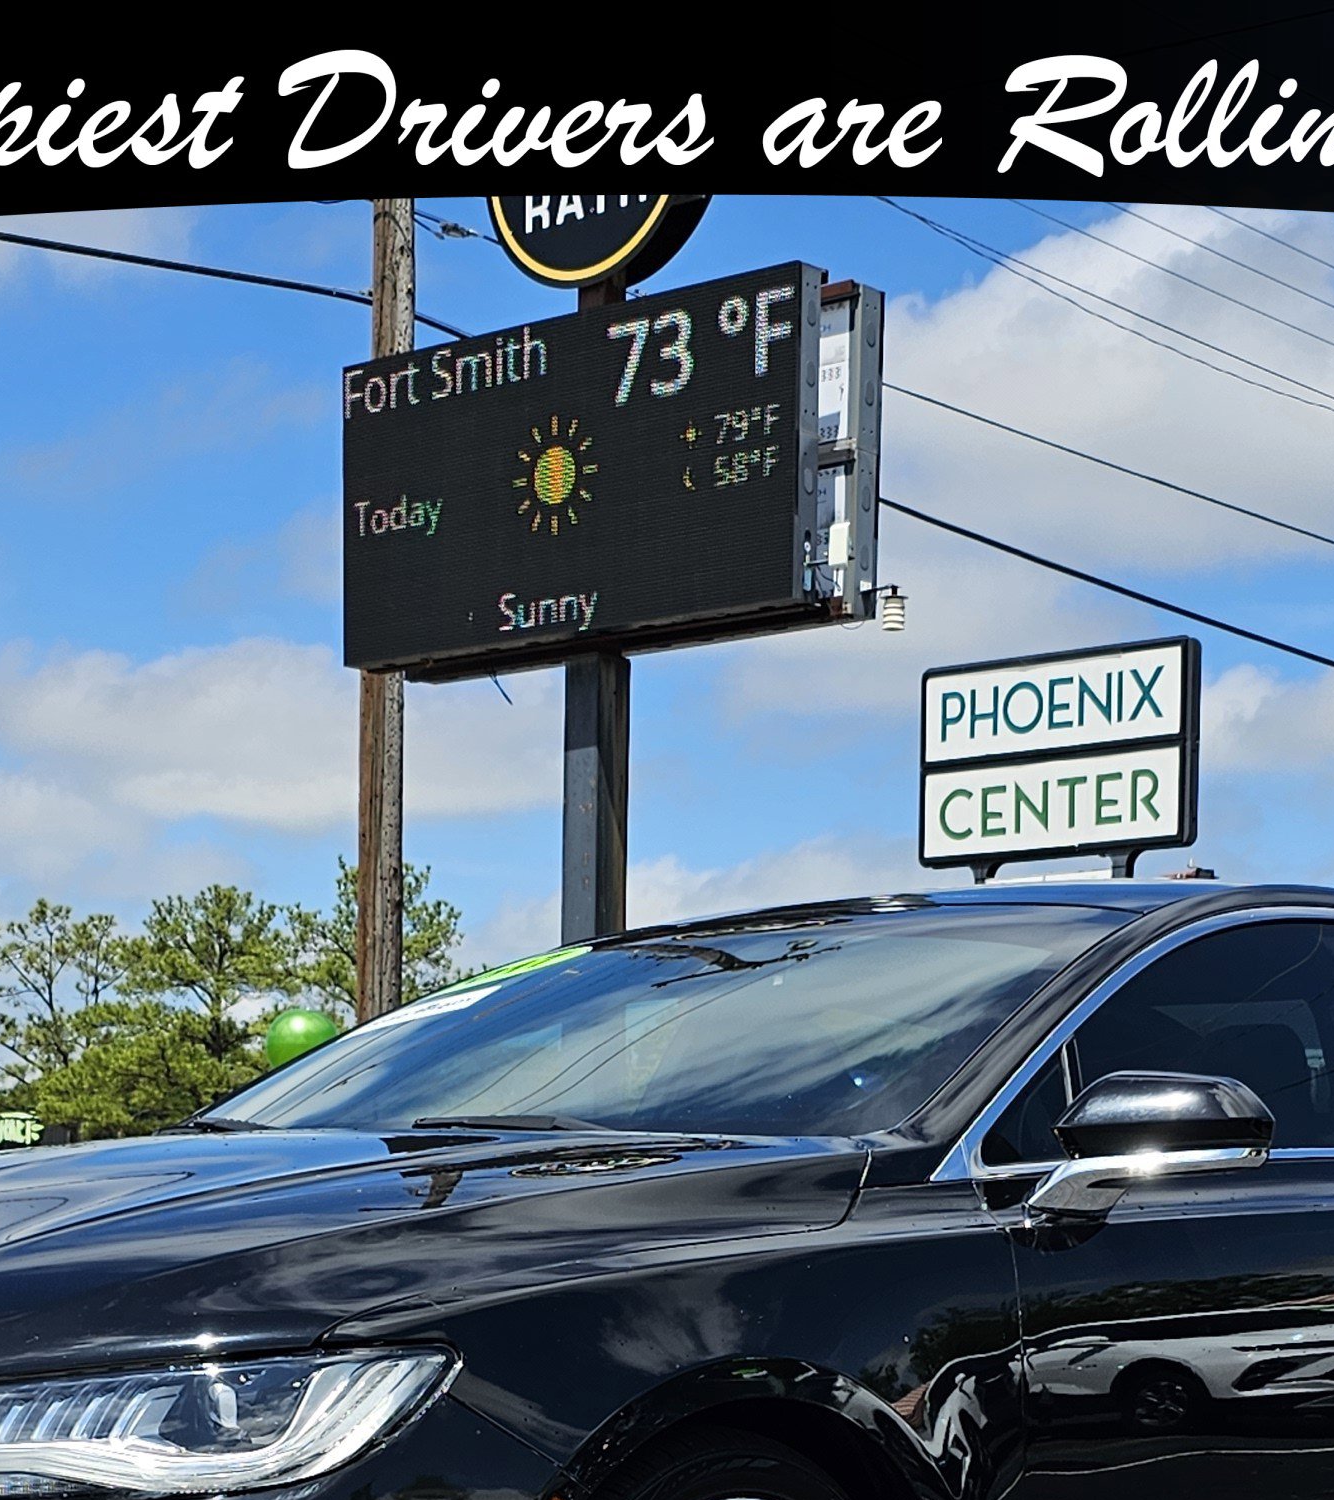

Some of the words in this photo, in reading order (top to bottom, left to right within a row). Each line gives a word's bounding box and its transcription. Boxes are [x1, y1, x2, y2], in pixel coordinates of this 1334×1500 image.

[343, 360, 421, 420] Fort
[430, 325, 547, 401] Smith
[606, 308, 695, 408] 73
[714, 403, 781, 445] 79°F
[352, 494, 443, 538] Today
[497, 592, 599, 632] Sunny
[940, 664, 1166, 743] PHOENIX
[939, 768, 1161, 841] CENTER
